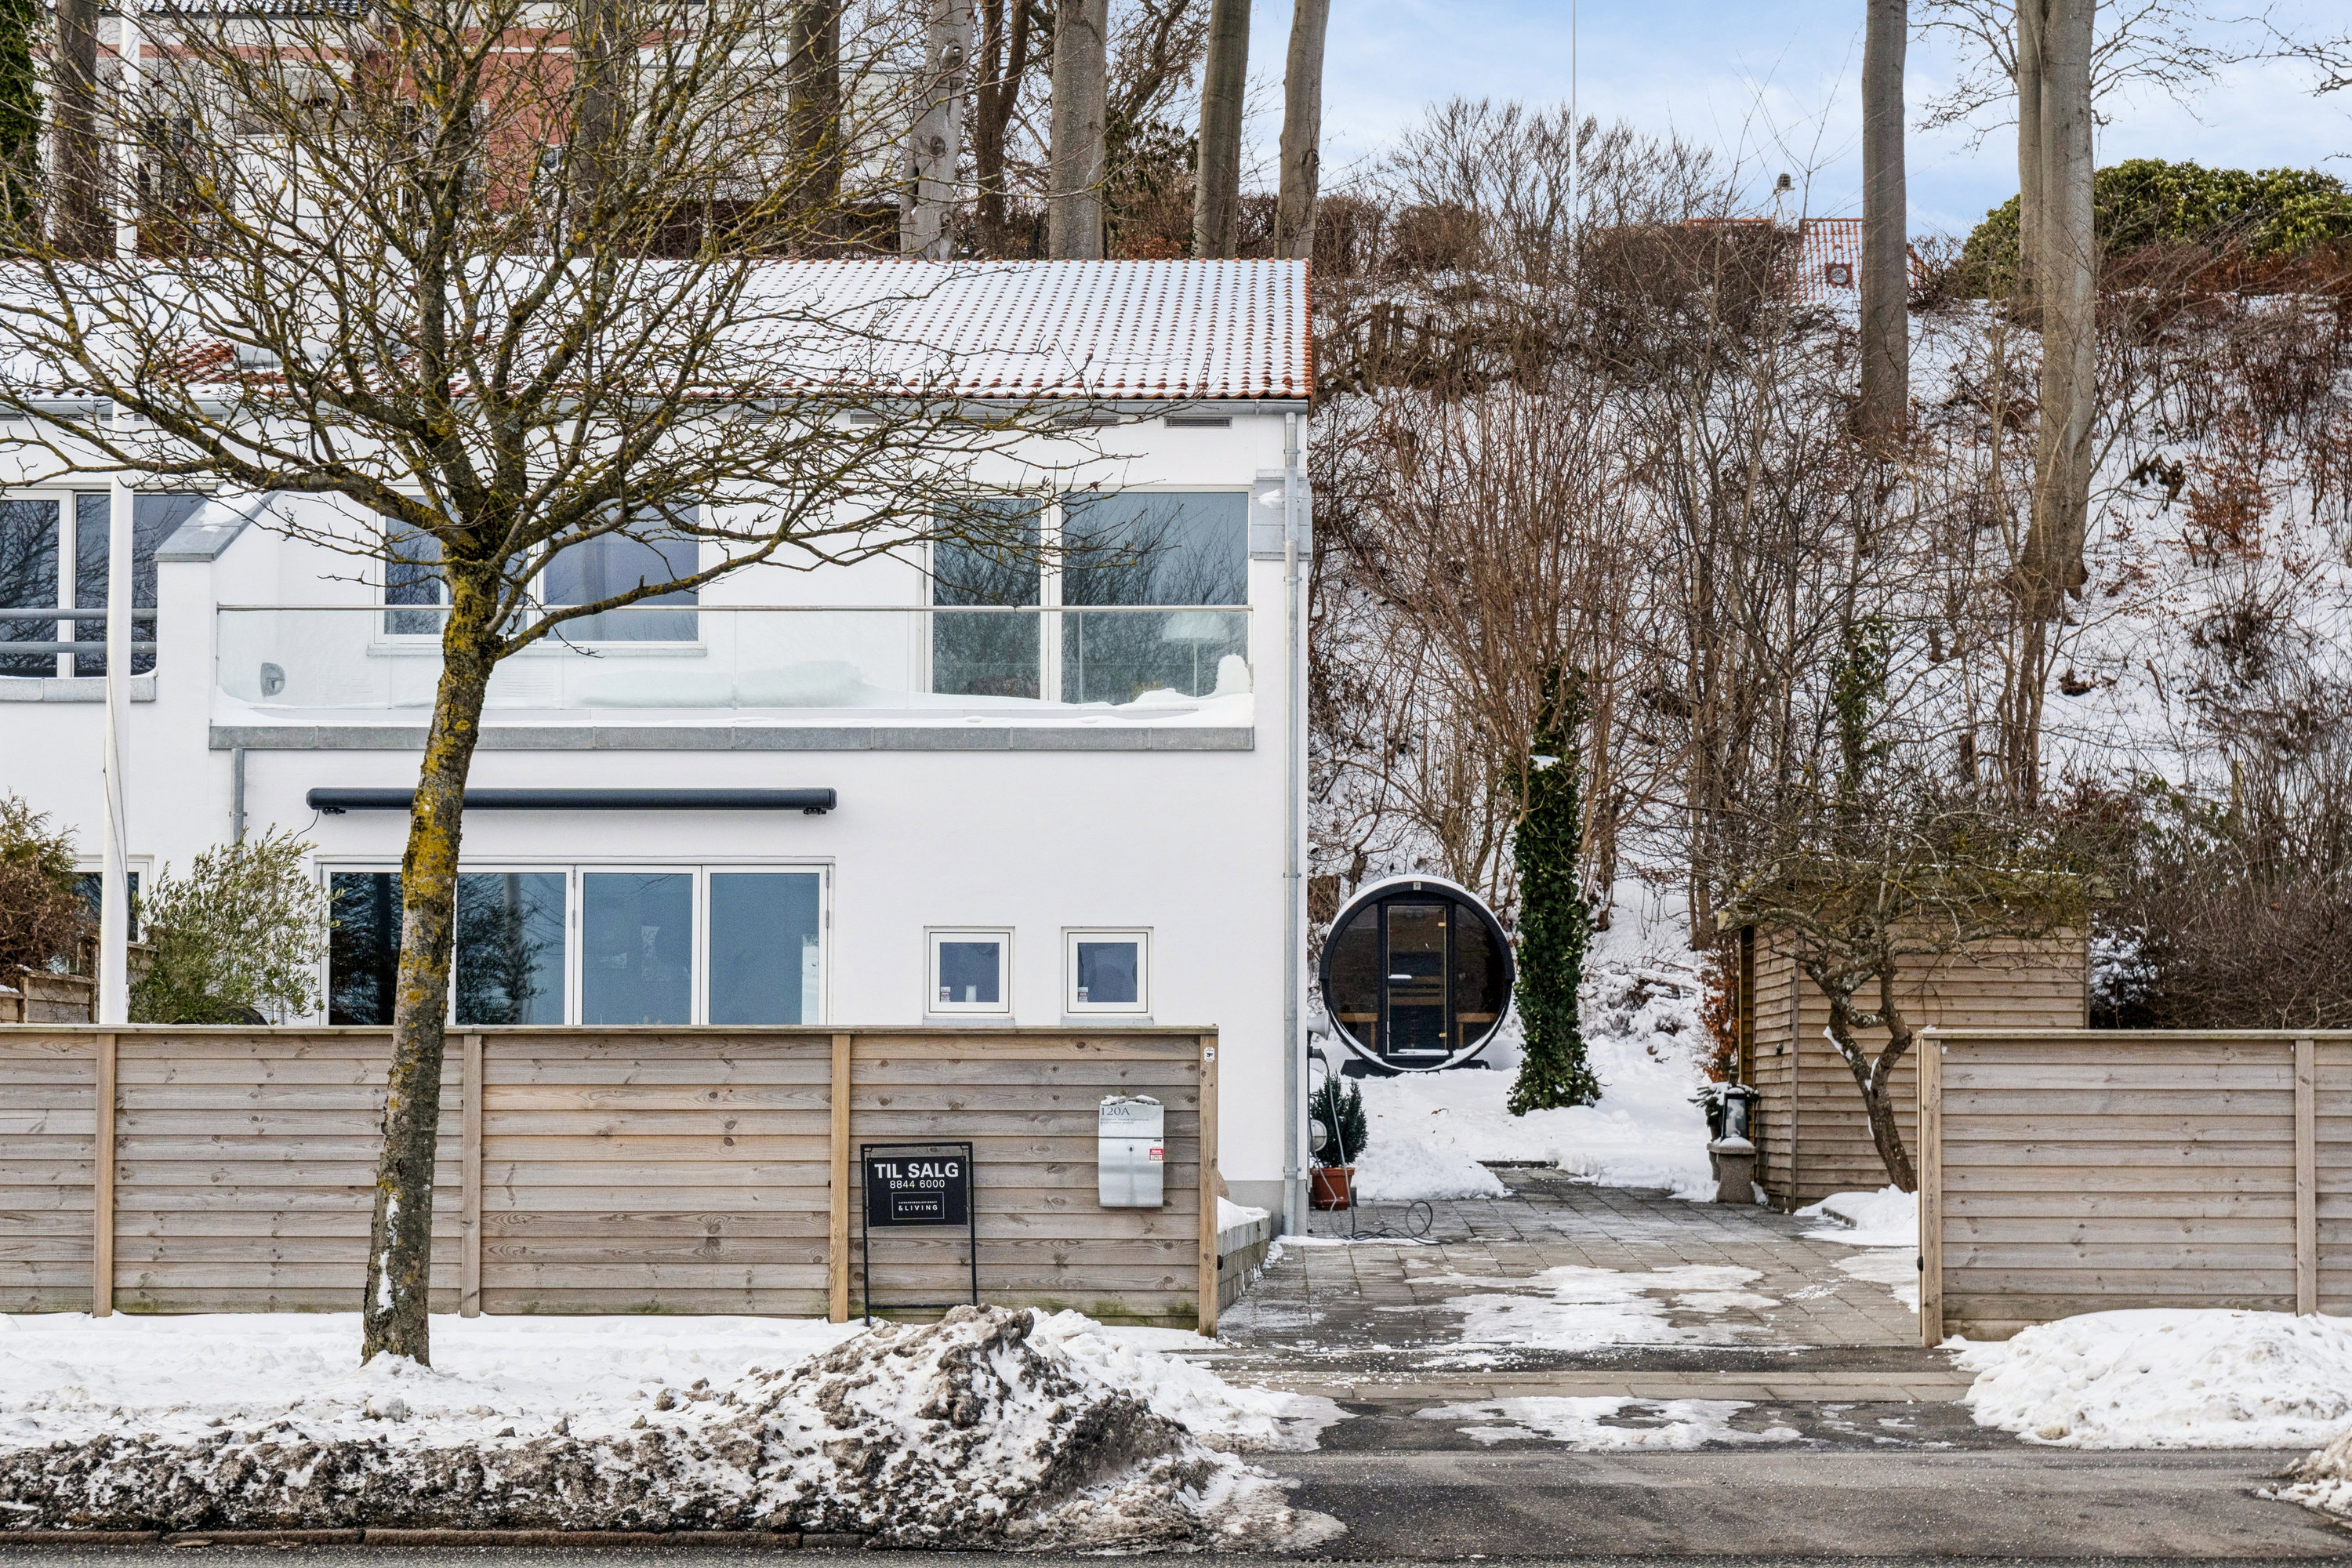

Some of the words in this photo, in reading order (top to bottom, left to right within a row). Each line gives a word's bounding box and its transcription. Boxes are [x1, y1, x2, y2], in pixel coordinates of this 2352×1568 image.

[1101, 1107, 1130, 1116] 120A
[874, 1163, 902, 1178] TIL
[908, 1162, 959, 1178] SALG
[890, 1180, 915, 1189] 8844
[920, 1179, 946, 1189] 6000
